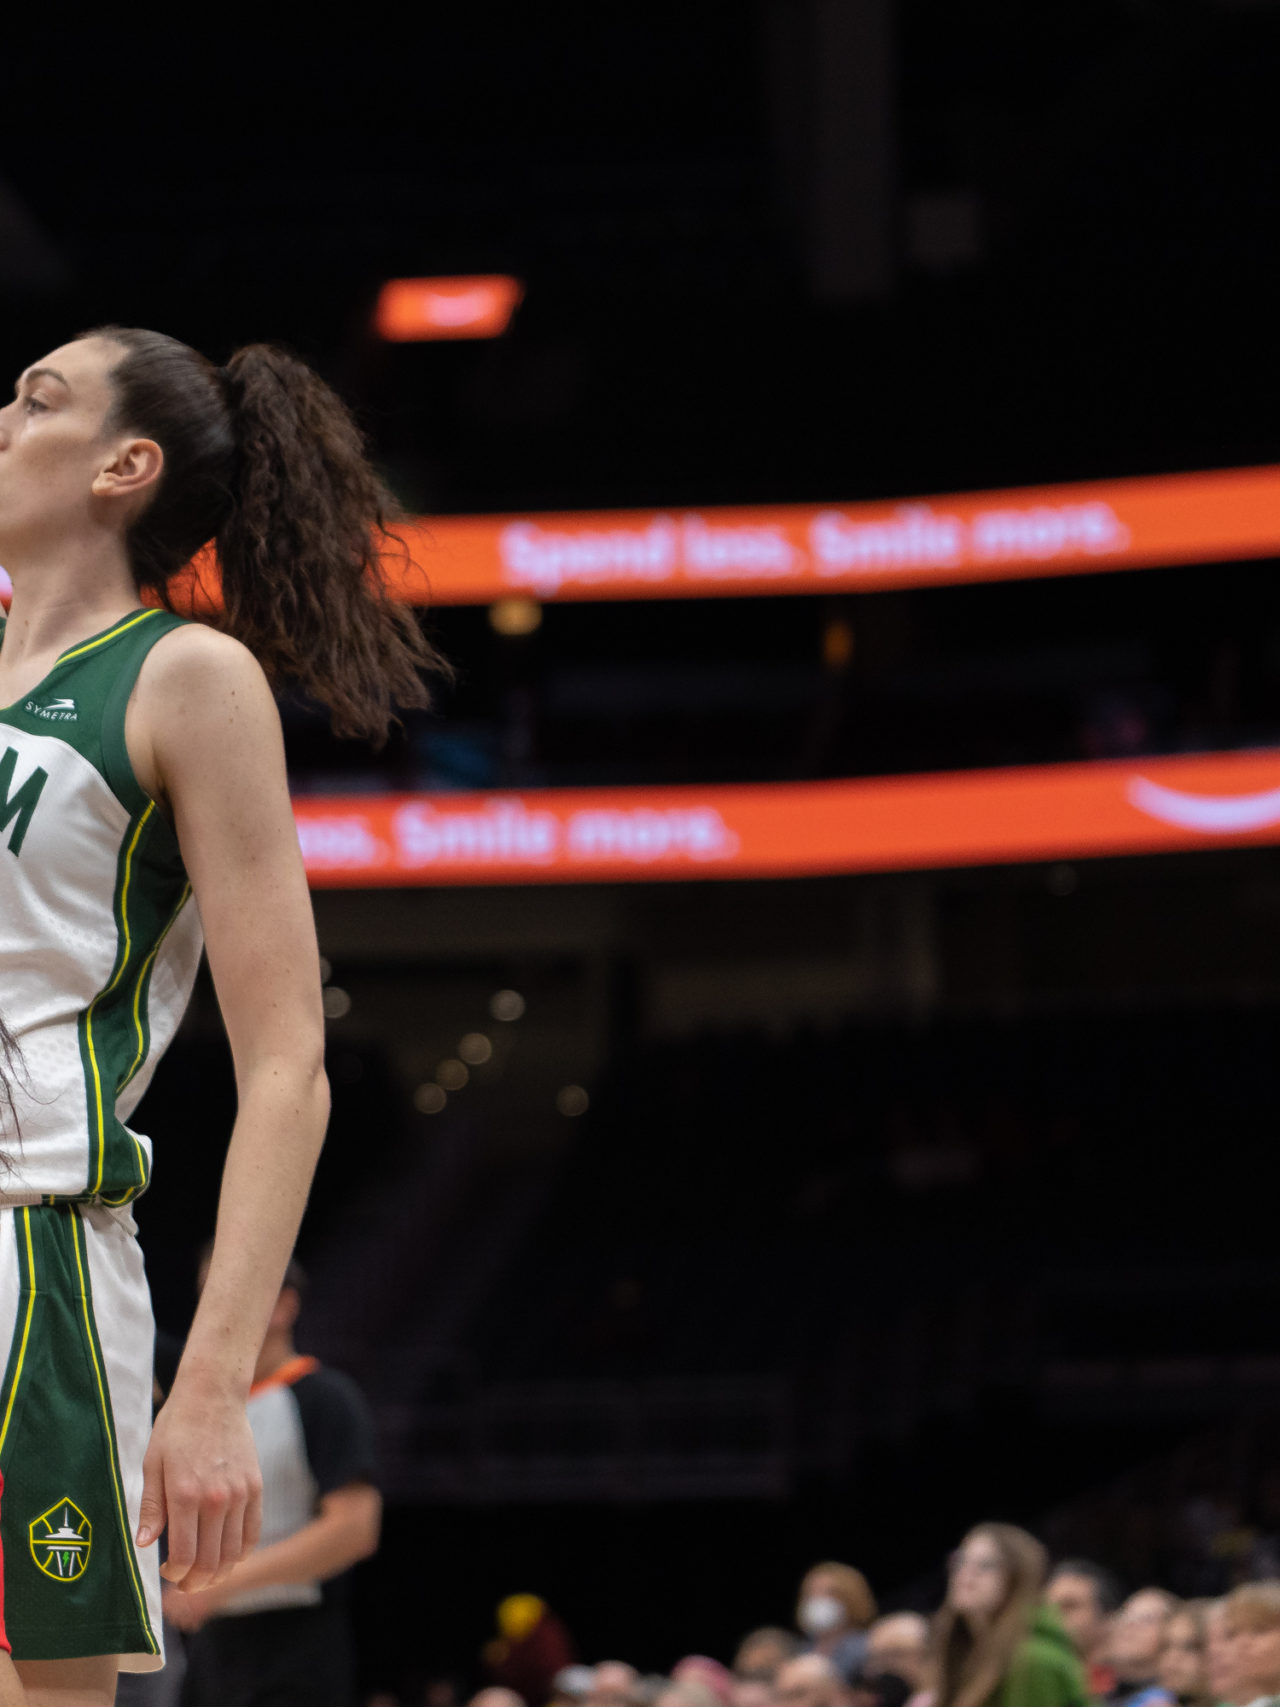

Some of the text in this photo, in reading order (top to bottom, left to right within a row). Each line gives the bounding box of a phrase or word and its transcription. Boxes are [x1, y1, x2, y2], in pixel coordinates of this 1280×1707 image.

[501, 520, 674, 597] Spend
[811, 502, 962, 577] Smile
[970, 502, 1129, 563] more.
[25, 701, 78, 721] SYMETRA
[393, 800, 558, 869] Smile
[568, 805, 741, 864] more.
